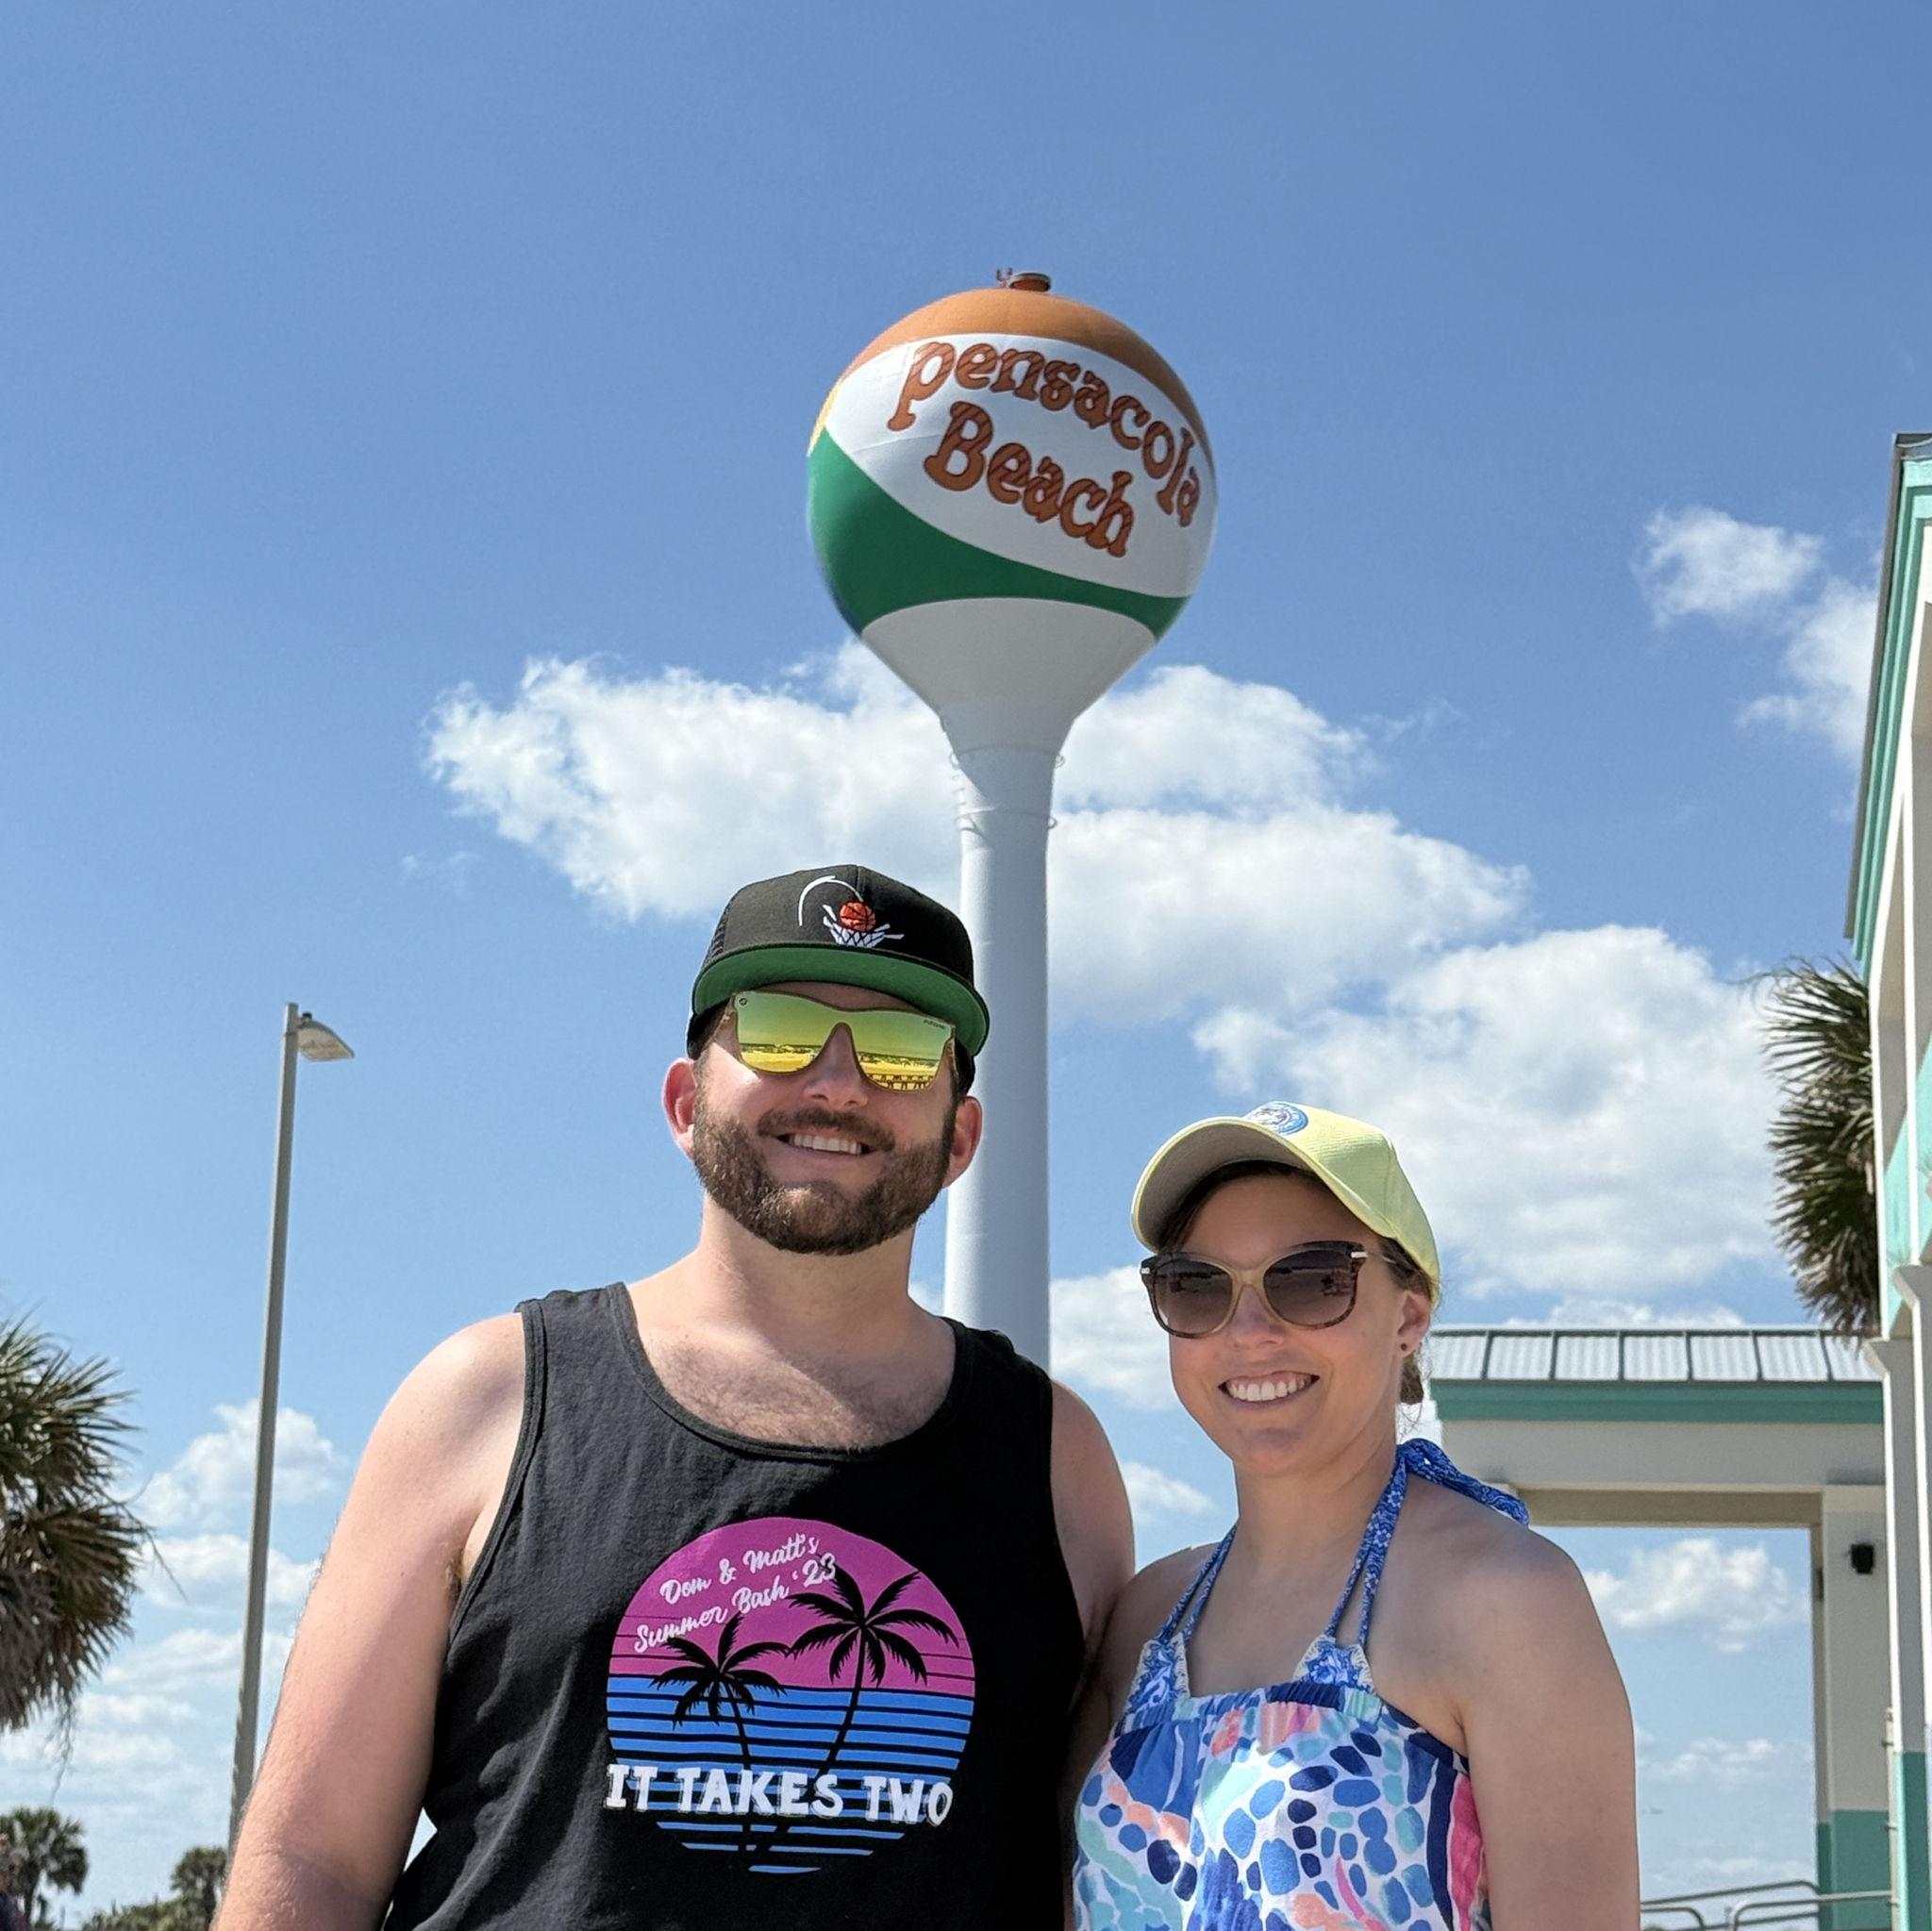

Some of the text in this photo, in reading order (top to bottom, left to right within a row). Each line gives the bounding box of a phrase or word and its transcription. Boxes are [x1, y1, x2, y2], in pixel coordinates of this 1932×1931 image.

[923, 400, 1134, 558] Beach
[659, 1533, 820, 1605] Dom & Matt's
[634, 1606, 728, 1653] Summer
[731, 1574, 791, 1614] Bash
[603, 1764, 954, 1827] IT TAKES TWO
